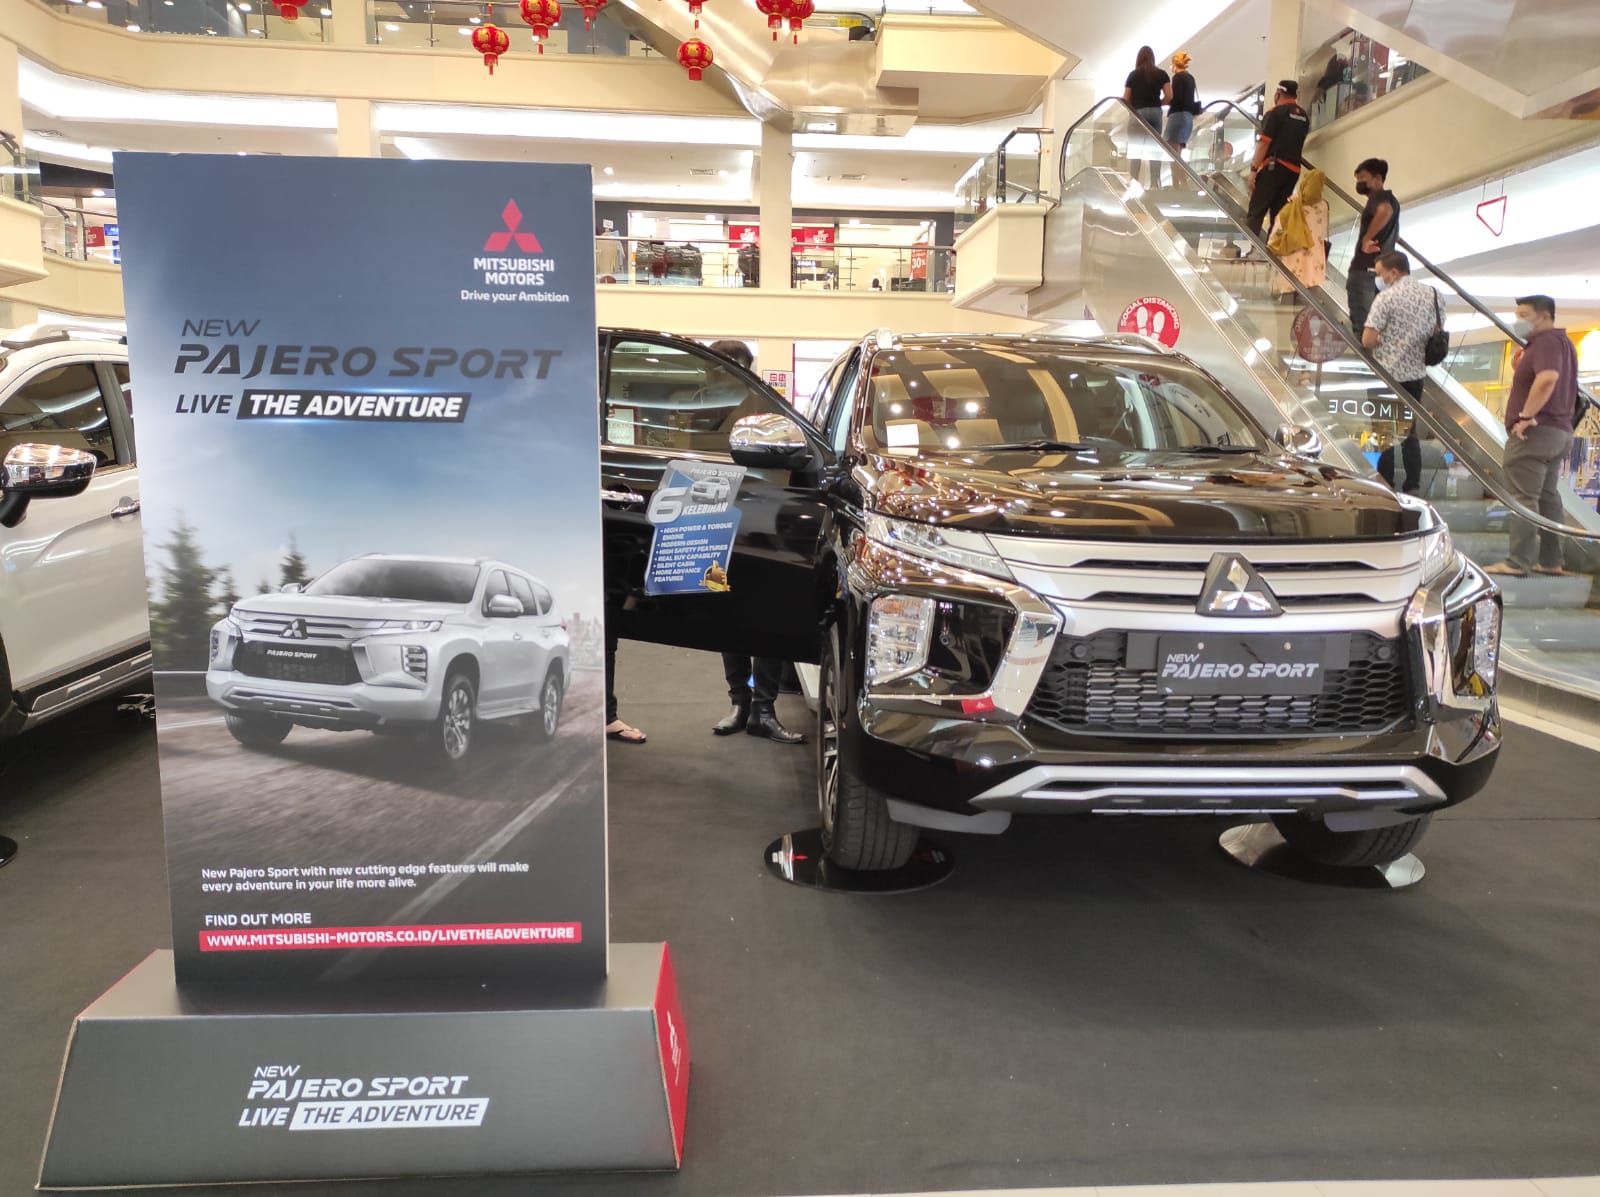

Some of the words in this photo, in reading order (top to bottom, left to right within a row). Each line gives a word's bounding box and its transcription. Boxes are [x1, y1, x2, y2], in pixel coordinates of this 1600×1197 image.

[473, 257, 554, 272] MITSUBISHI
[485, 272, 544, 285] MOTORS
[461, 290, 490, 301] Drive
[492, 292, 517, 303] your
[519, 291, 569, 302] Ambition
[1121, 300, 1143, 326] SOCIAL
[1143, 298, 1180, 330] DISTANCING
[182, 319, 261, 337] NEW
[174, 343, 377, 380] PAJERO
[388, 347, 562, 379] SPORT
[175, 394, 233, 414] LIVE
[249, 394, 302, 415] THE
[304, 394, 463, 418] ADVENTURE
[648, 487, 689, 523] 6
[682, 502, 728, 516] KELEBIHAN
[266, 649, 293, 657] PAJERO
[294, 651, 318, 659] SPORT
[1166, 653, 1200, 663] NEW
[1161, 663, 1245, 680] PAJERO
[1247, 663, 1319, 678] SPORT
[201, 868, 227, 878] New
[230, 867, 265, 879] Pajero
[267, 867, 299, 879] Sport
[301, 866, 327, 876] with
[329, 867, 352, 875] new
[355, 865, 396, 875] cutting
[398, 864, 426, 876] edge
[429, 863, 476, 874] features
[478, 862, 497, 873] will
[499, 862, 529, 873] make
[201, 882, 233, 893] every
[236, 881, 293, 890] adventure
[296, 879, 306, 890] in
[308, 880, 334, 891] your
[336, 879, 354, 889] life
[356, 879, 386, 888] more
[388, 877, 416, 888] alive.
[205, 914, 237, 926] FIND
[241, 913, 268, 925] OUT
[272, 912, 311, 924] MORE
[207, 927, 574, 946] WWW.MITSUBISHI-MOTORS.CO.ID/LIVETHEADVENTURE
[254, 1065, 300, 1077] NEW
[247, 1078, 363, 1101] PAJERO
[368, 1075, 468, 1097] SPORT
[238, 1106, 290, 1127] LIVE
[303, 1106, 344, 1124] THE
[347, 1103, 479, 1123] ADVENTURE
